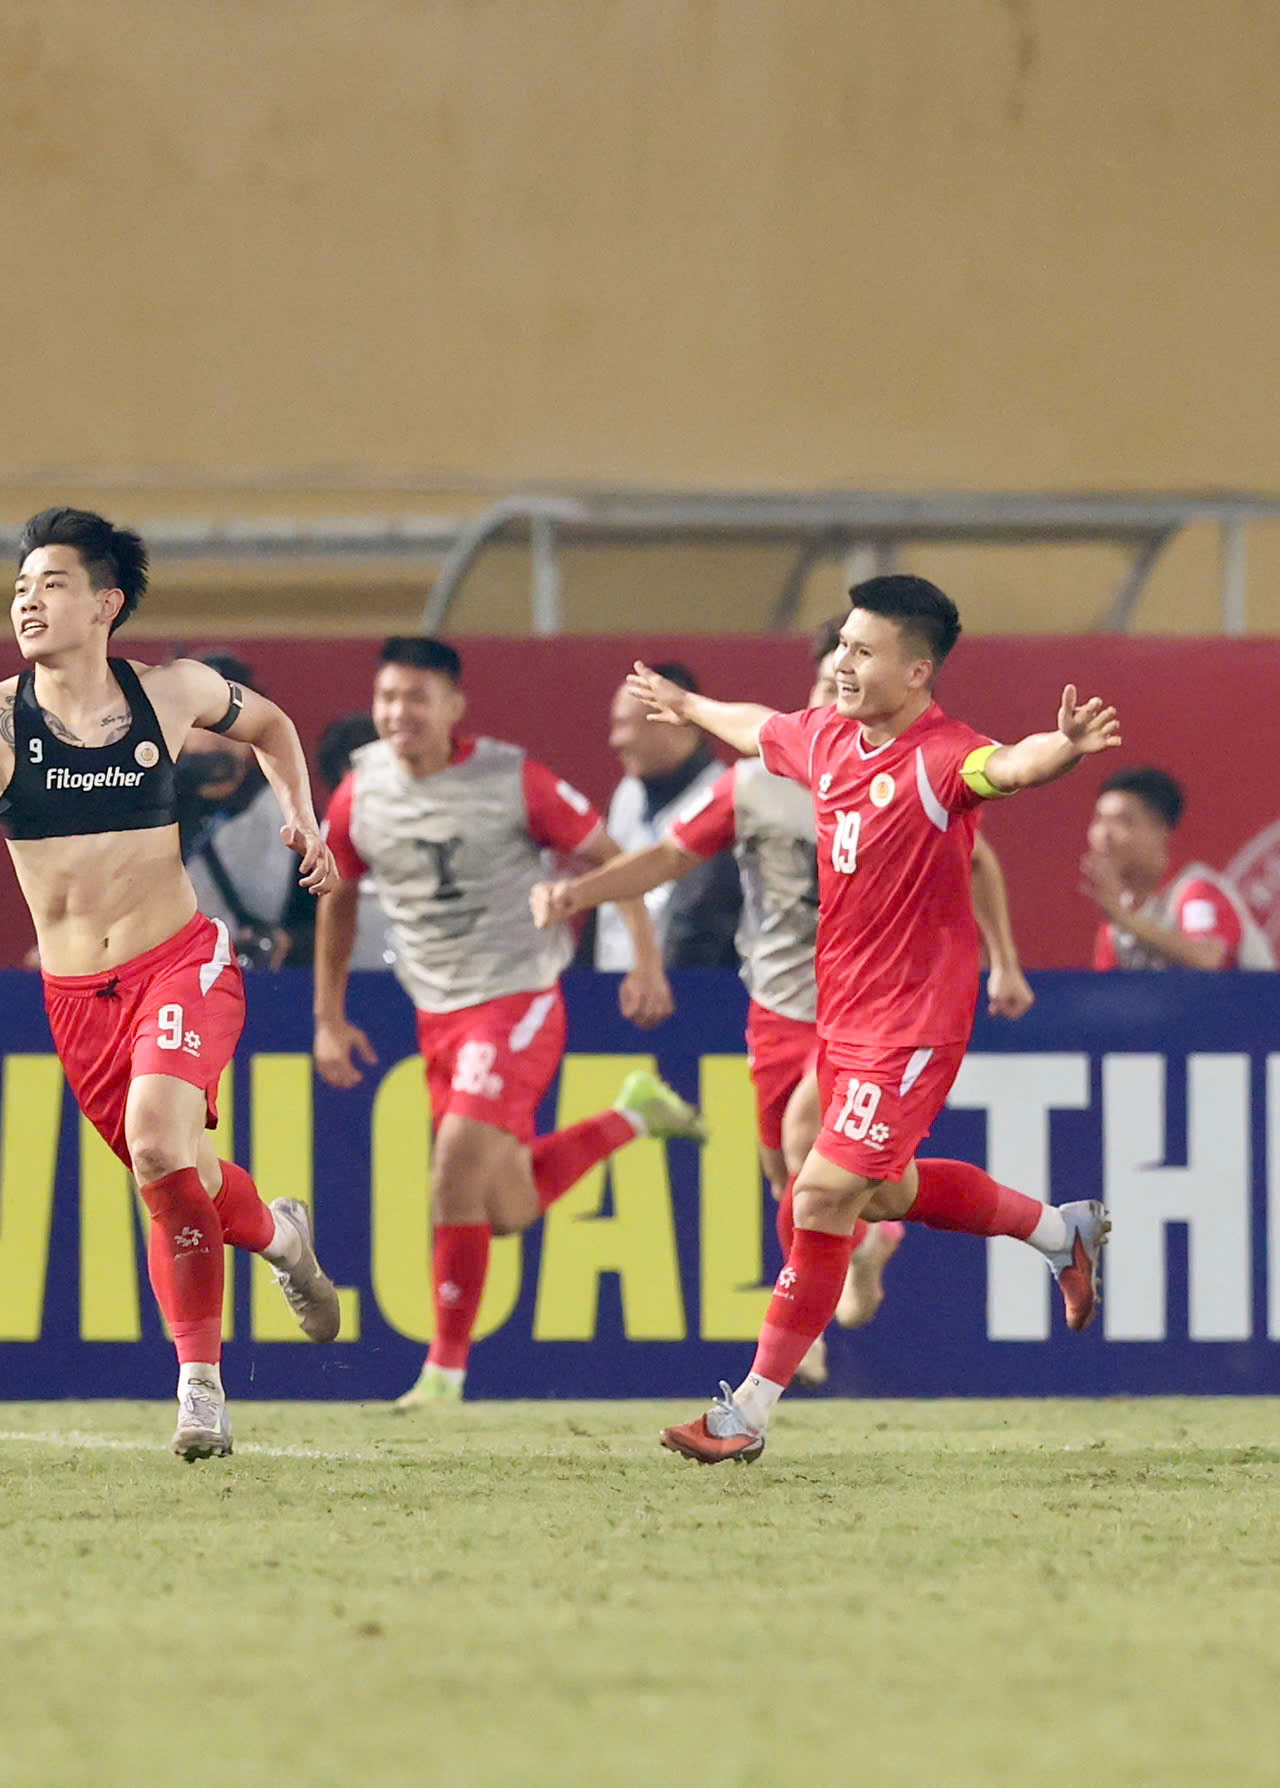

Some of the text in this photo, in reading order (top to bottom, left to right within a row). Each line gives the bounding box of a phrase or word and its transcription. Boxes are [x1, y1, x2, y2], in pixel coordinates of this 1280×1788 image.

[28, 737, 44, 764] 9
[46, 766, 145, 792] Fitogether
[831, 809, 862, 875] 19
[156, 1003, 184, 1050] 9
[833, 1078, 882, 1141] 19
[946, 1052, 1280, 1341] TH
